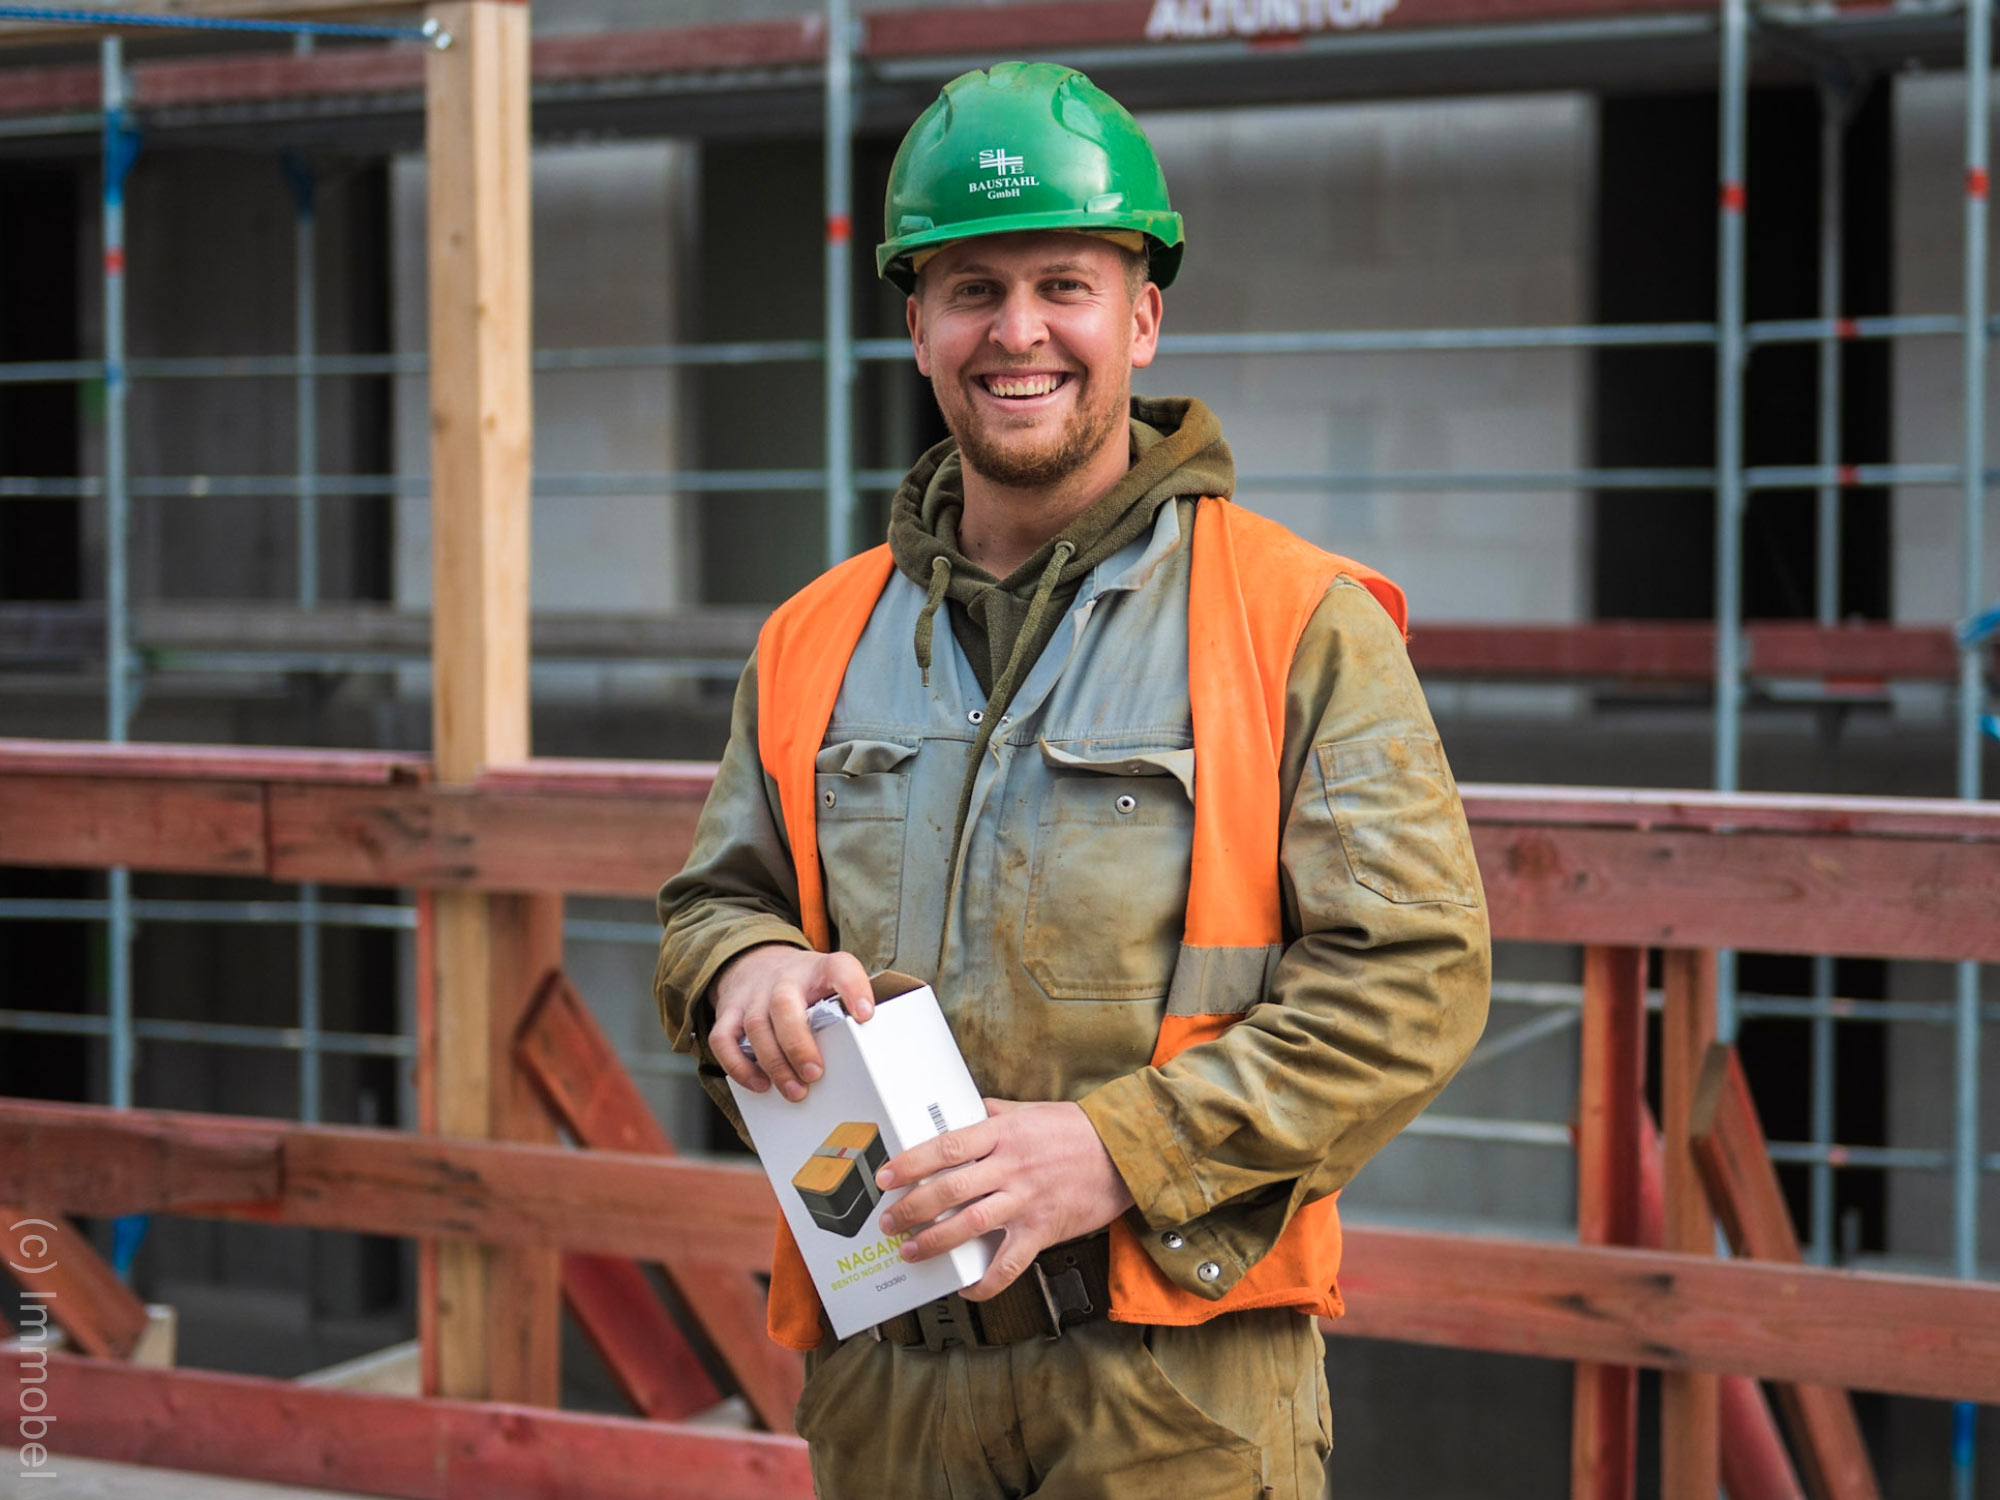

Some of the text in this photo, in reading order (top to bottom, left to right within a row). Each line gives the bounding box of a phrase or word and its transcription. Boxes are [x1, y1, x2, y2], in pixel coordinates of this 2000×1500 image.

[1145, 0, 1400, 39] ALTUNTOP
[968, 176, 1040, 193] BAUSTAHL
[987, 188, 1021, 200] GmbH
[831, 1272, 860, 1291] BENTO
[861, 1263, 882, 1277] NOIR
